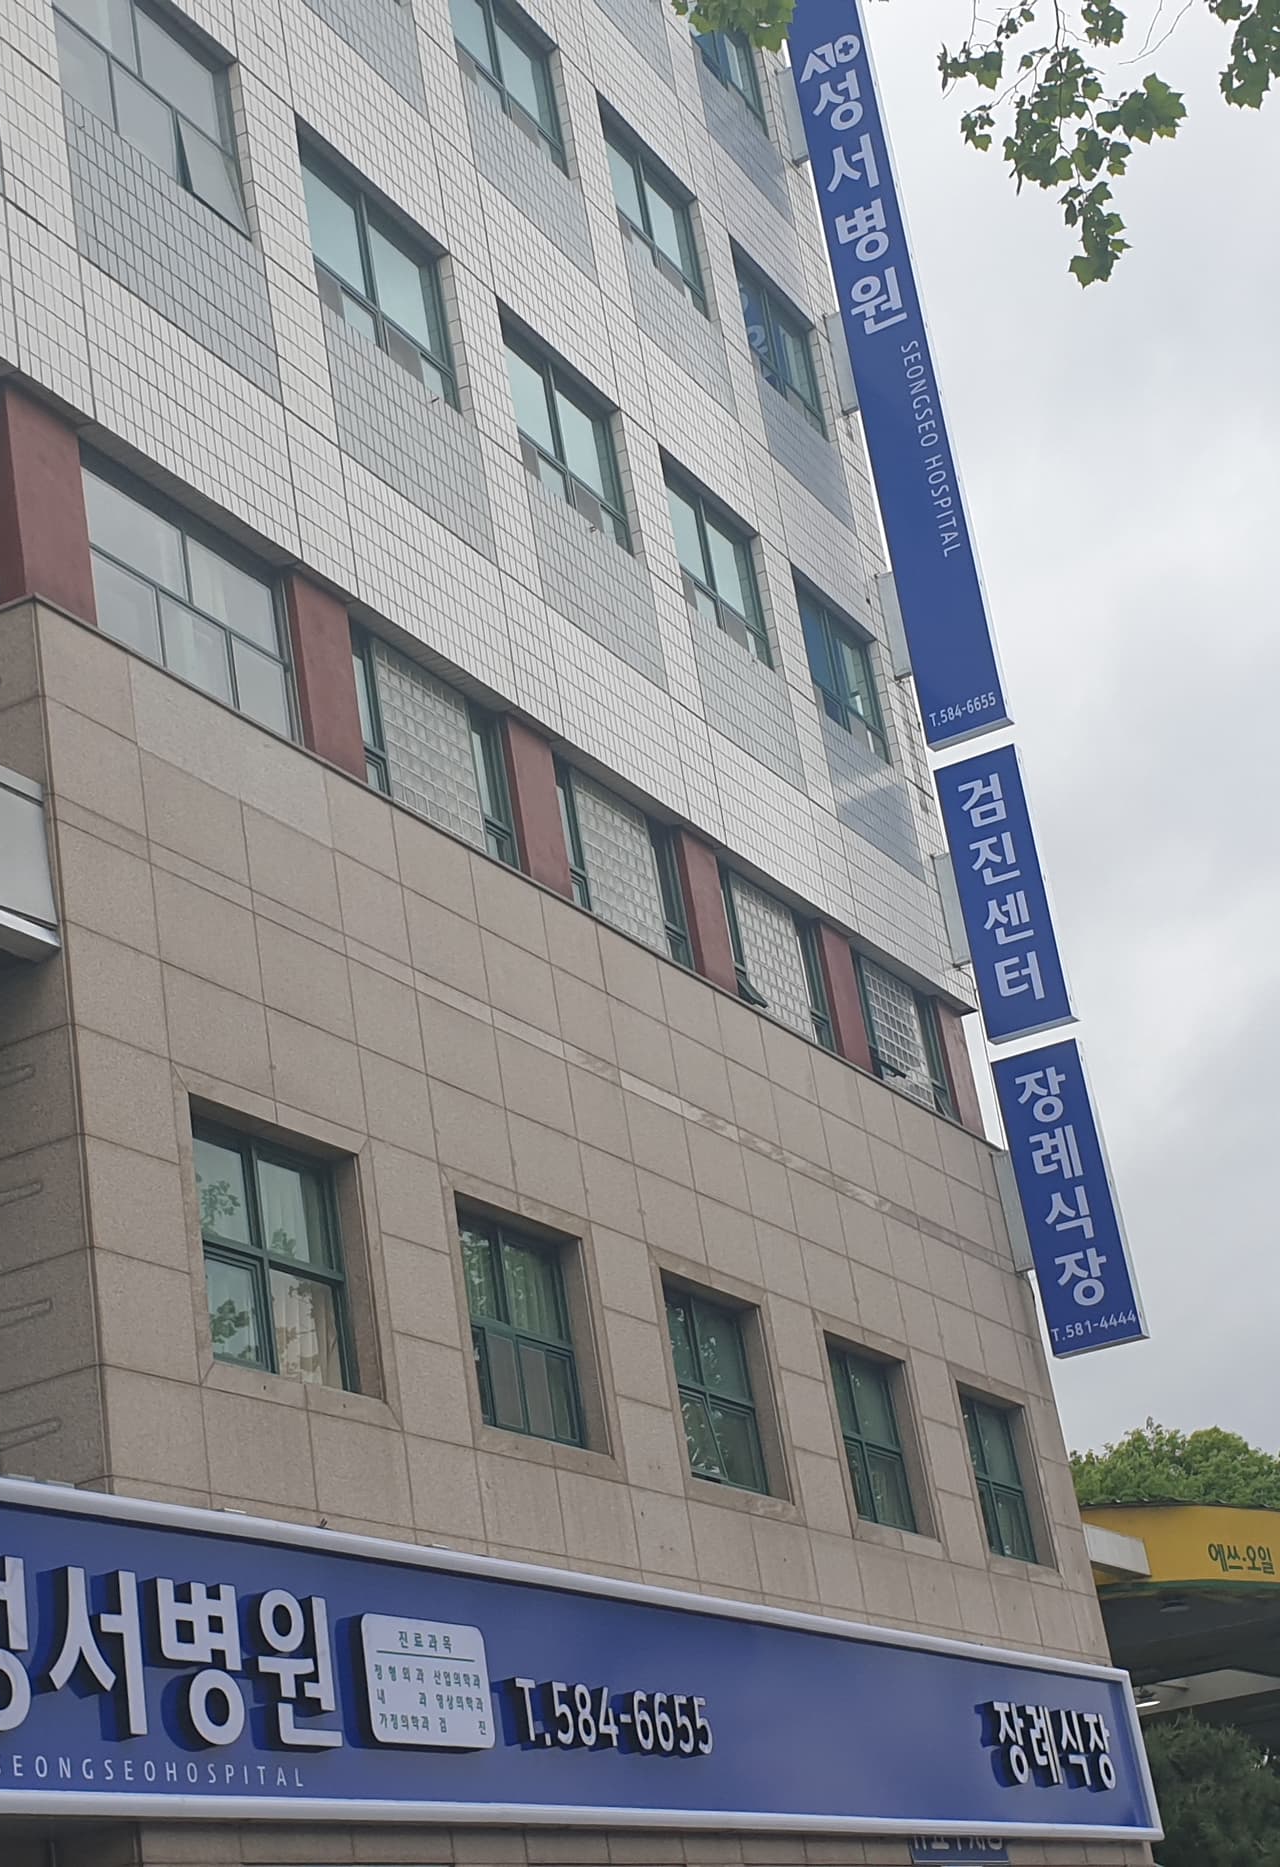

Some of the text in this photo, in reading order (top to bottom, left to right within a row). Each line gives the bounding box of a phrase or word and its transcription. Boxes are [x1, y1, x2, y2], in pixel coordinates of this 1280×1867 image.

[813, 69, 907, 335] 성서병원
[901, 340, 961, 558] SEONGSEO HOSPITAL
[929, 692, 997, 728] T.584-6655
[958, 773, 1047, 1002] 검진센터
[1015, 1066, 1108, 1307] 장례식장
[1051, 1310, 1137, 1343] T.581-4444
[515, 1677, 713, 1754] T.584-6655
[992, 1701, 1117, 1790] 장례식장
